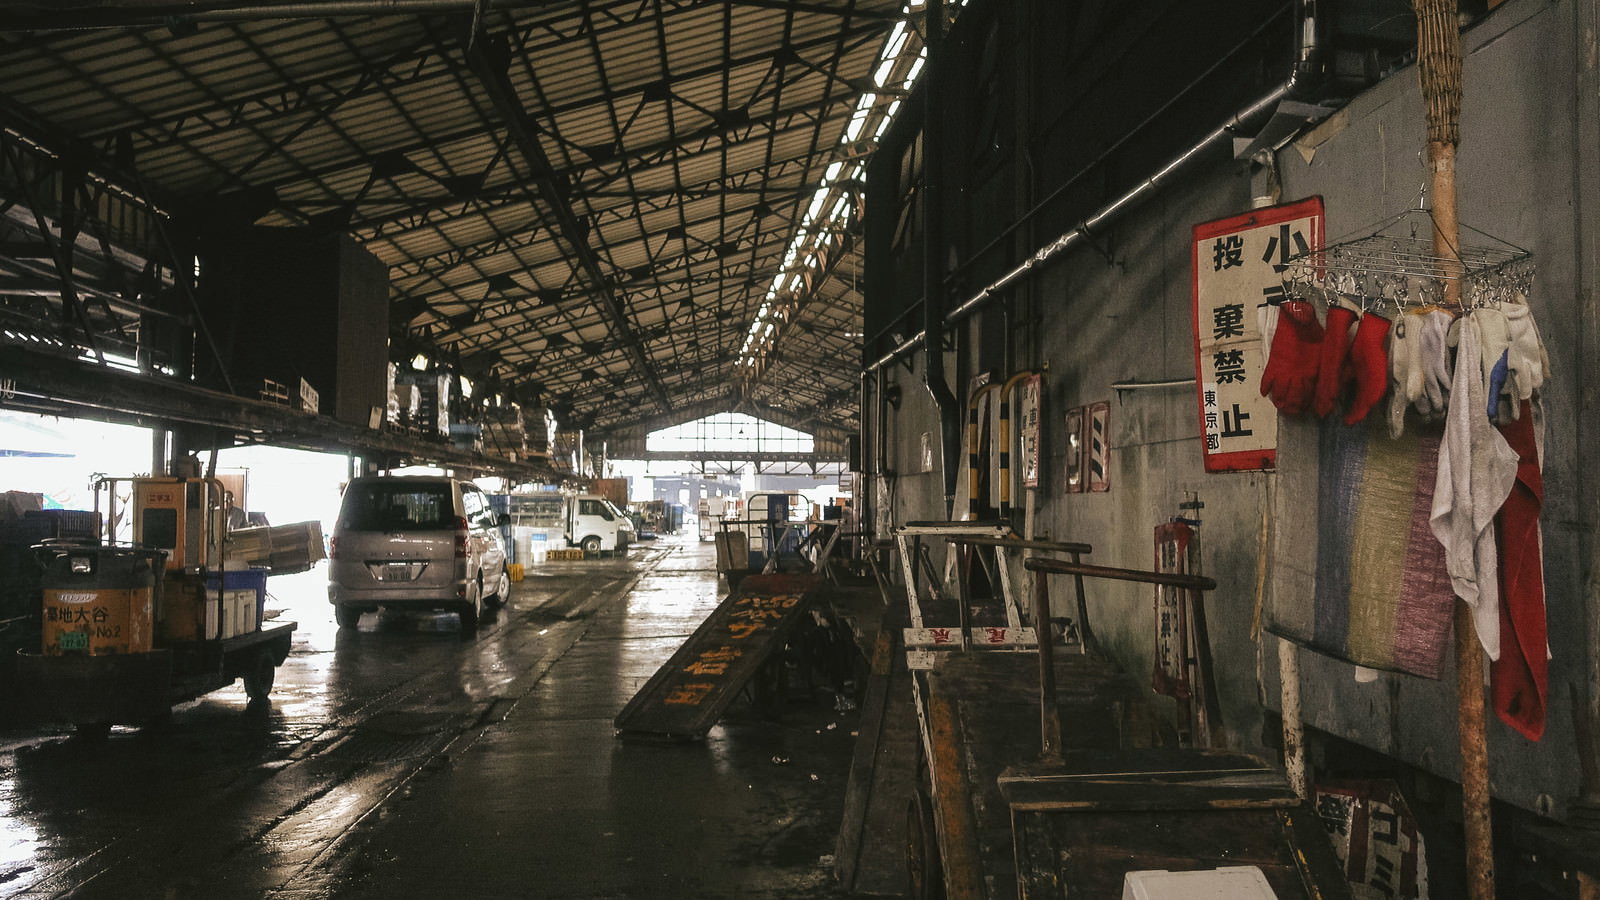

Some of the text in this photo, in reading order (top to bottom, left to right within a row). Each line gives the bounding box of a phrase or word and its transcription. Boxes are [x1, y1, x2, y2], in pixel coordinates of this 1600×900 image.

[1213, 235, 1253, 438] 投棄禁止
[1204, 390, 1219, 450] 東京都
[96, 625, 121, 639] No.2
